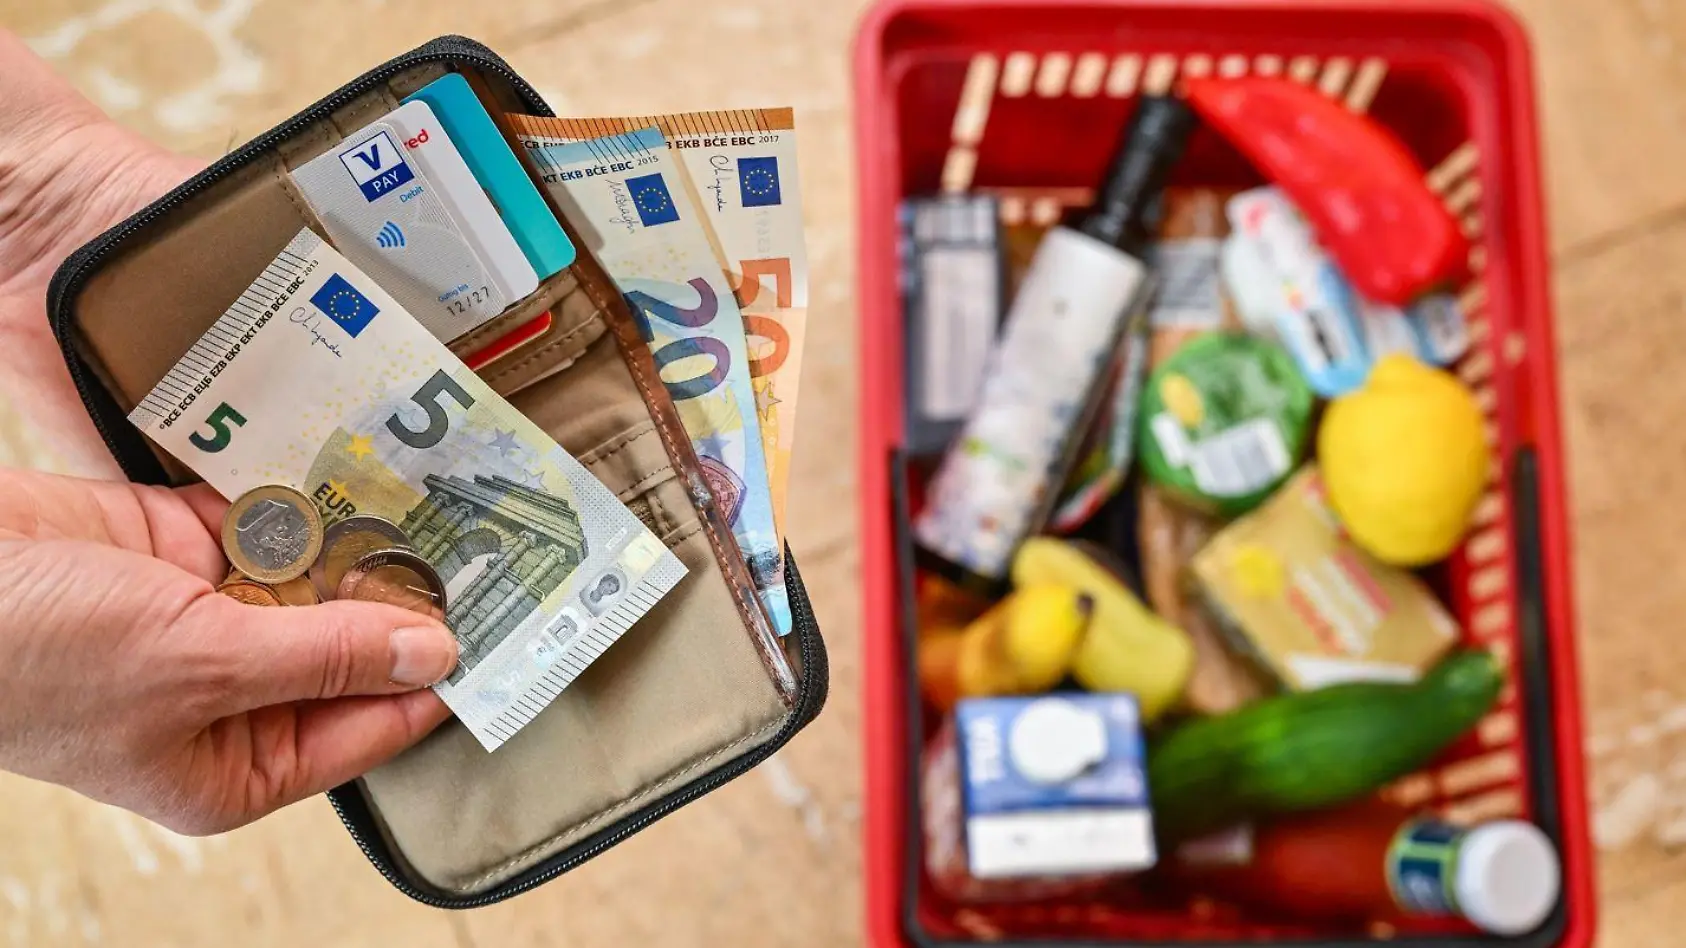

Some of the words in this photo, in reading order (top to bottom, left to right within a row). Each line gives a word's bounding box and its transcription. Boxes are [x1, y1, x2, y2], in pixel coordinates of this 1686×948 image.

[676, 139, 701, 150] EKB
[704, 135, 728, 148] BČE
[731, 136, 755, 146] EBC
[759, 135, 779, 144] 2017
[372, 170, 401, 193] PAY
[560, 168, 584, 182] EKB
[585, 165, 609, 178] BČE
[609, 161, 634, 173] EBC
[637, 155, 659, 167] 2015
[399, 186, 424, 203] Debit
[447, 286, 489, 317] 12/27
[732, 258, 791, 379] 50
[178, 392, 197, 412] ECB
[209, 359, 228, 378] EZB
[224, 343, 242, 362] EKP
[240, 326, 258, 346] EKT
[255, 309, 274, 329] EKB
[270, 291, 289, 313] BČE
[286, 275, 305, 295] EBC
[303, 259, 319, 277] 2013
[622, 277, 731, 401] 20
[188, 401, 248, 454] 5
[385, 368, 476, 449] 5
